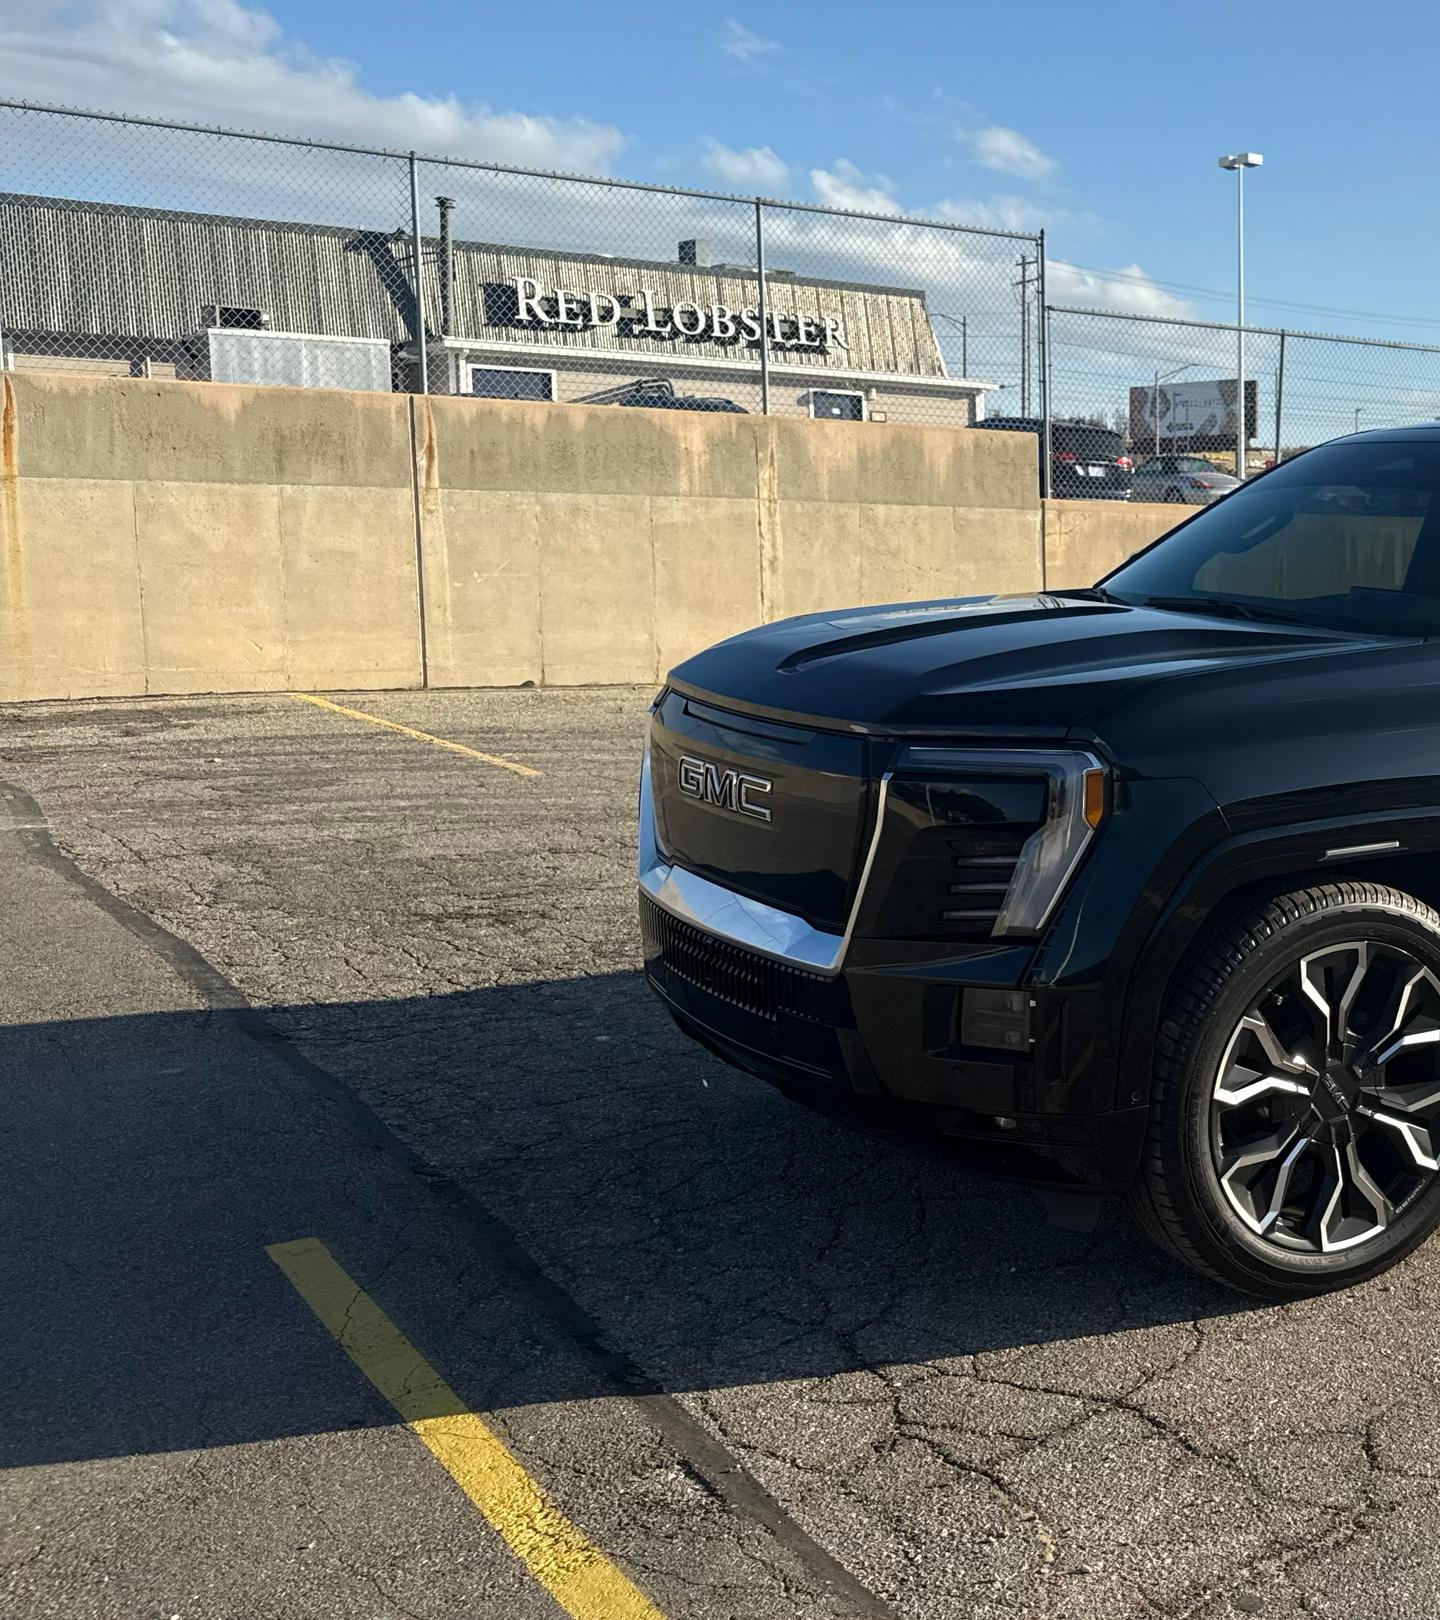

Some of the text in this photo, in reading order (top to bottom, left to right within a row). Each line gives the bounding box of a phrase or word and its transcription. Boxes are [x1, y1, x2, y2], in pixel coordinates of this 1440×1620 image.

[511, 276, 849, 349] RED LOBSTER
[678, 755, 772, 822] GMC
[1321, 1073, 1350, 1112] GMC
[1395, 1179, 1426, 1214] DENALI
